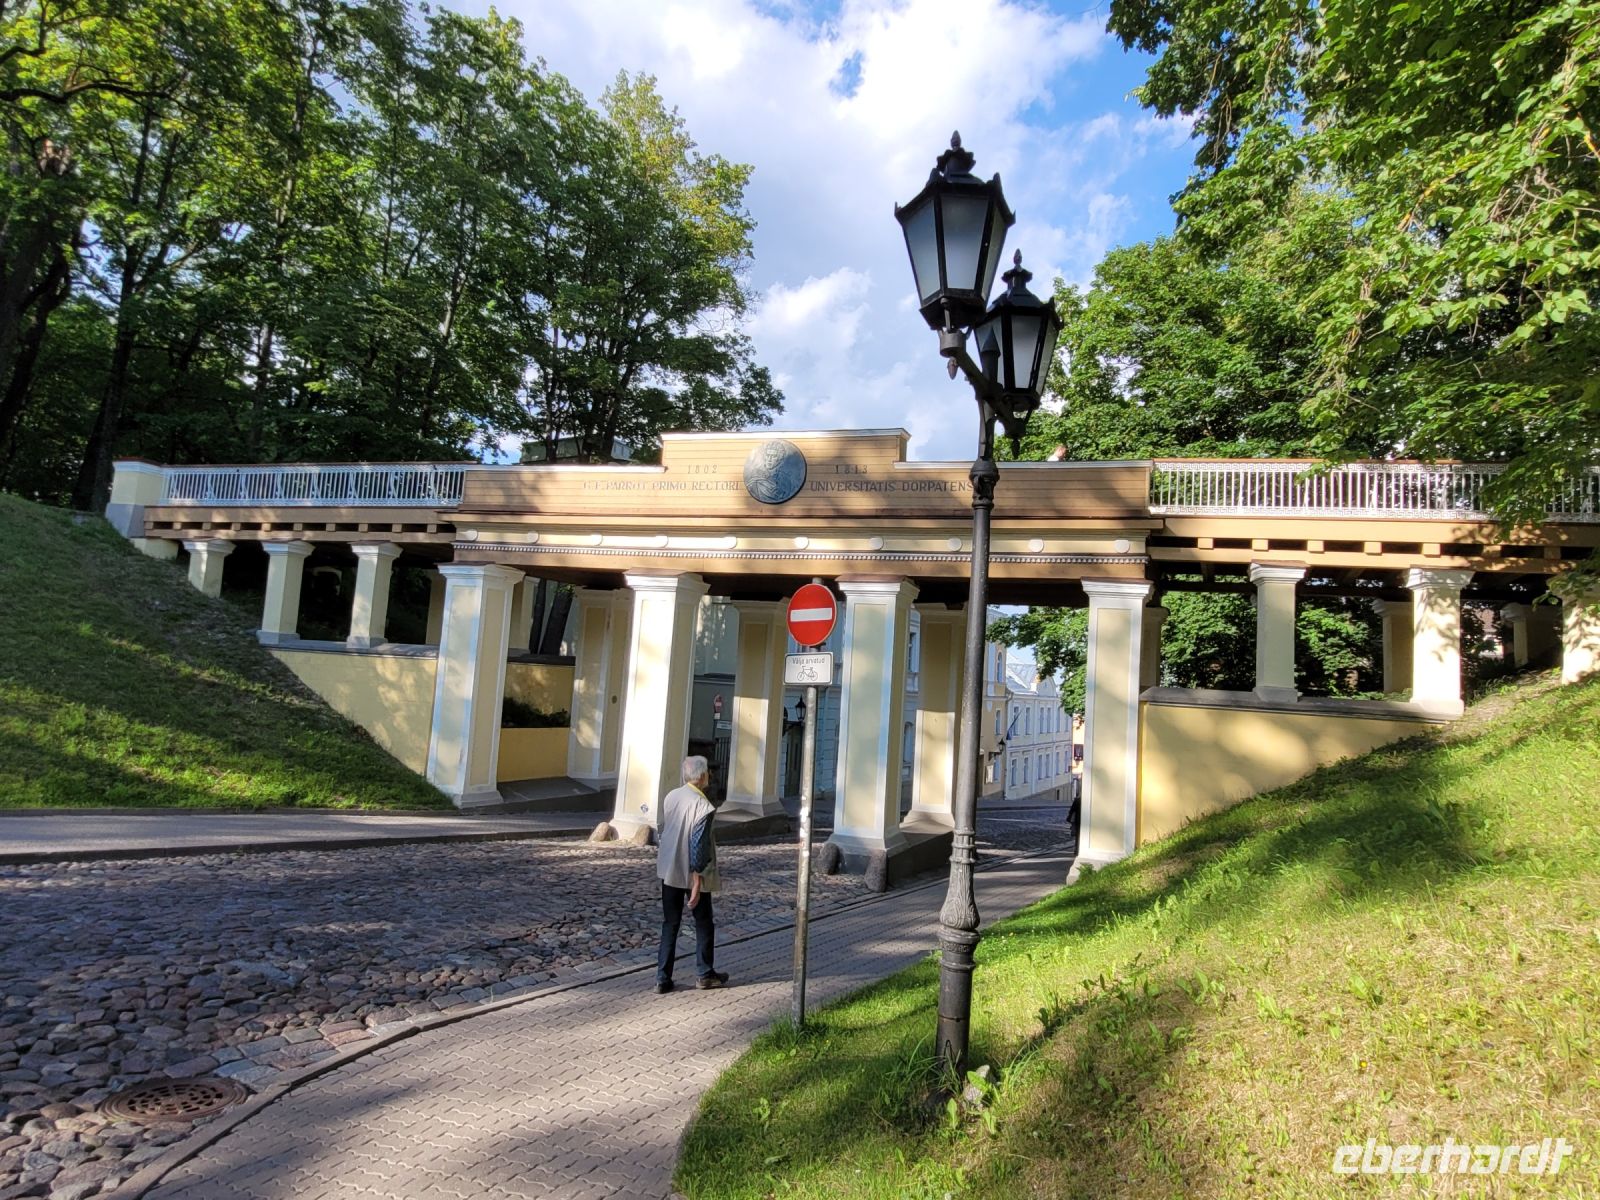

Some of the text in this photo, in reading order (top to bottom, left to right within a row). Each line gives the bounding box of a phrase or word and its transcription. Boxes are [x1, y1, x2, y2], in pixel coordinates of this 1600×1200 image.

[687, 464, 718, 474] 1802
[652, 480, 687, 491] PRIMO
[691, 480, 739, 491] RECTORI
[809, 480, 897, 492] UNIVERSITATIS
